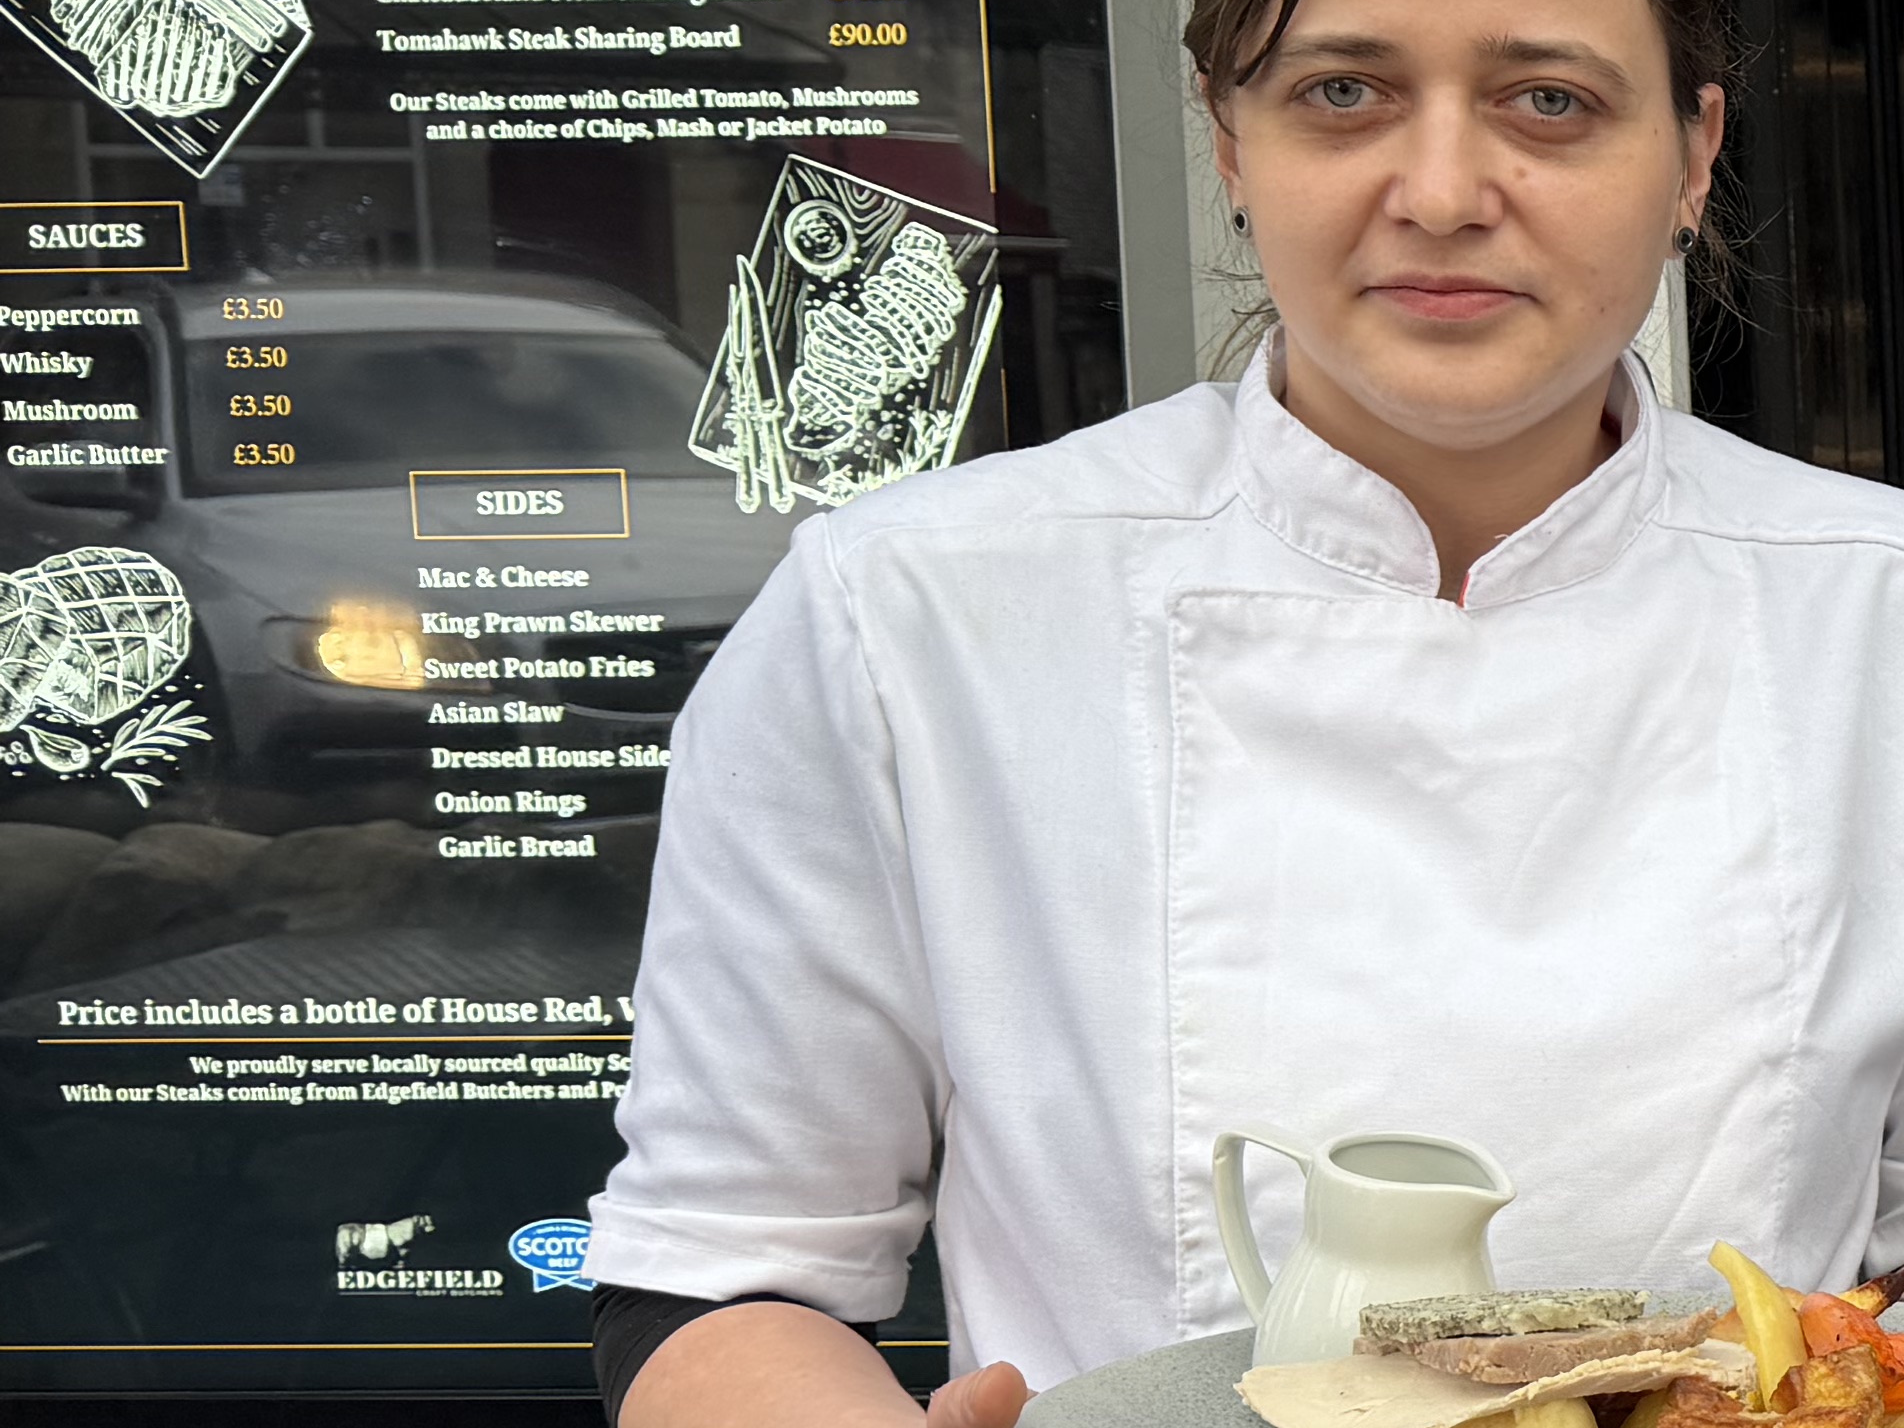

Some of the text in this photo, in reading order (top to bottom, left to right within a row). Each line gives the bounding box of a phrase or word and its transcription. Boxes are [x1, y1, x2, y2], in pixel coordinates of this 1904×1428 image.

[376, 24, 741, 55] Tomahawk Steak Sharing Board
[829, 23, 907, 46] £90.00
[390, 86, 919, 111] Our Steaks come with Grilled Tomato, Mushrooms
[426, 116, 887, 144] and a choice of Chips, Mash or Jacket Potato
[29, 223, 145, 248] SAUCES
[0, 306, 141, 332] Peppercorn
[222, 298, 283, 320] £3.50
[0, 351, 93, 378] Whisky
[226, 347, 287, 368] £3.50
[2, 399, 138, 421] Mushroom
[230, 395, 291, 416] £3.50
[7, 443, 169, 470] Garlic Butter
[234, 444, 295, 465] £3.50
[477, 490, 564, 515] SIDES
[418, 566, 589, 588] Mac & Cheese
[421, 611, 664, 638] King Prawn Skewer
[421, 655, 655, 683] Sweet Potato Fries
[428, 701, 565, 724] Asian Slaw
[431, 746, 533, 768] Dressed
[535, 747, 615, 767] House
[435, 790, 586, 817] Onion Rings
[438, 835, 596, 857] Garlic Bread
[58, 999, 138, 1025] Price
[144, 999, 273, 1025] includes
[280, 1005, 299, 1024] a
[304, 998, 396, 1024] bottle
[403, 997, 437, 1023] of
[440, 998, 538, 1023] House
[543, 996, 613, 1026] Red,
[189, 1057, 223, 1074] We
[226, 1055, 308, 1078] proudly
[311, 1059, 369, 1073] serve
[371, 1054, 441, 1077] locally
[444, 1054, 528, 1072] sourced
[530, 1053, 605, 1076] quality
[60, 1084, 113, 1102] With
[116, 1088, 154, 1102] our
[156, 1083, 224, 1101] Steaks
[227, 1083, 304, 1105] coming
[306, 1082, 358, 1100] from
[361, 1081, 459, 1105] Edgefield
[462, 1081, 555, 1099] Butchers
[558, 1080, 599, 1099] and
[517, 1237, 590, 1257] SCOTC
[337, 1270, 503, 1291] EDGEFIELD
